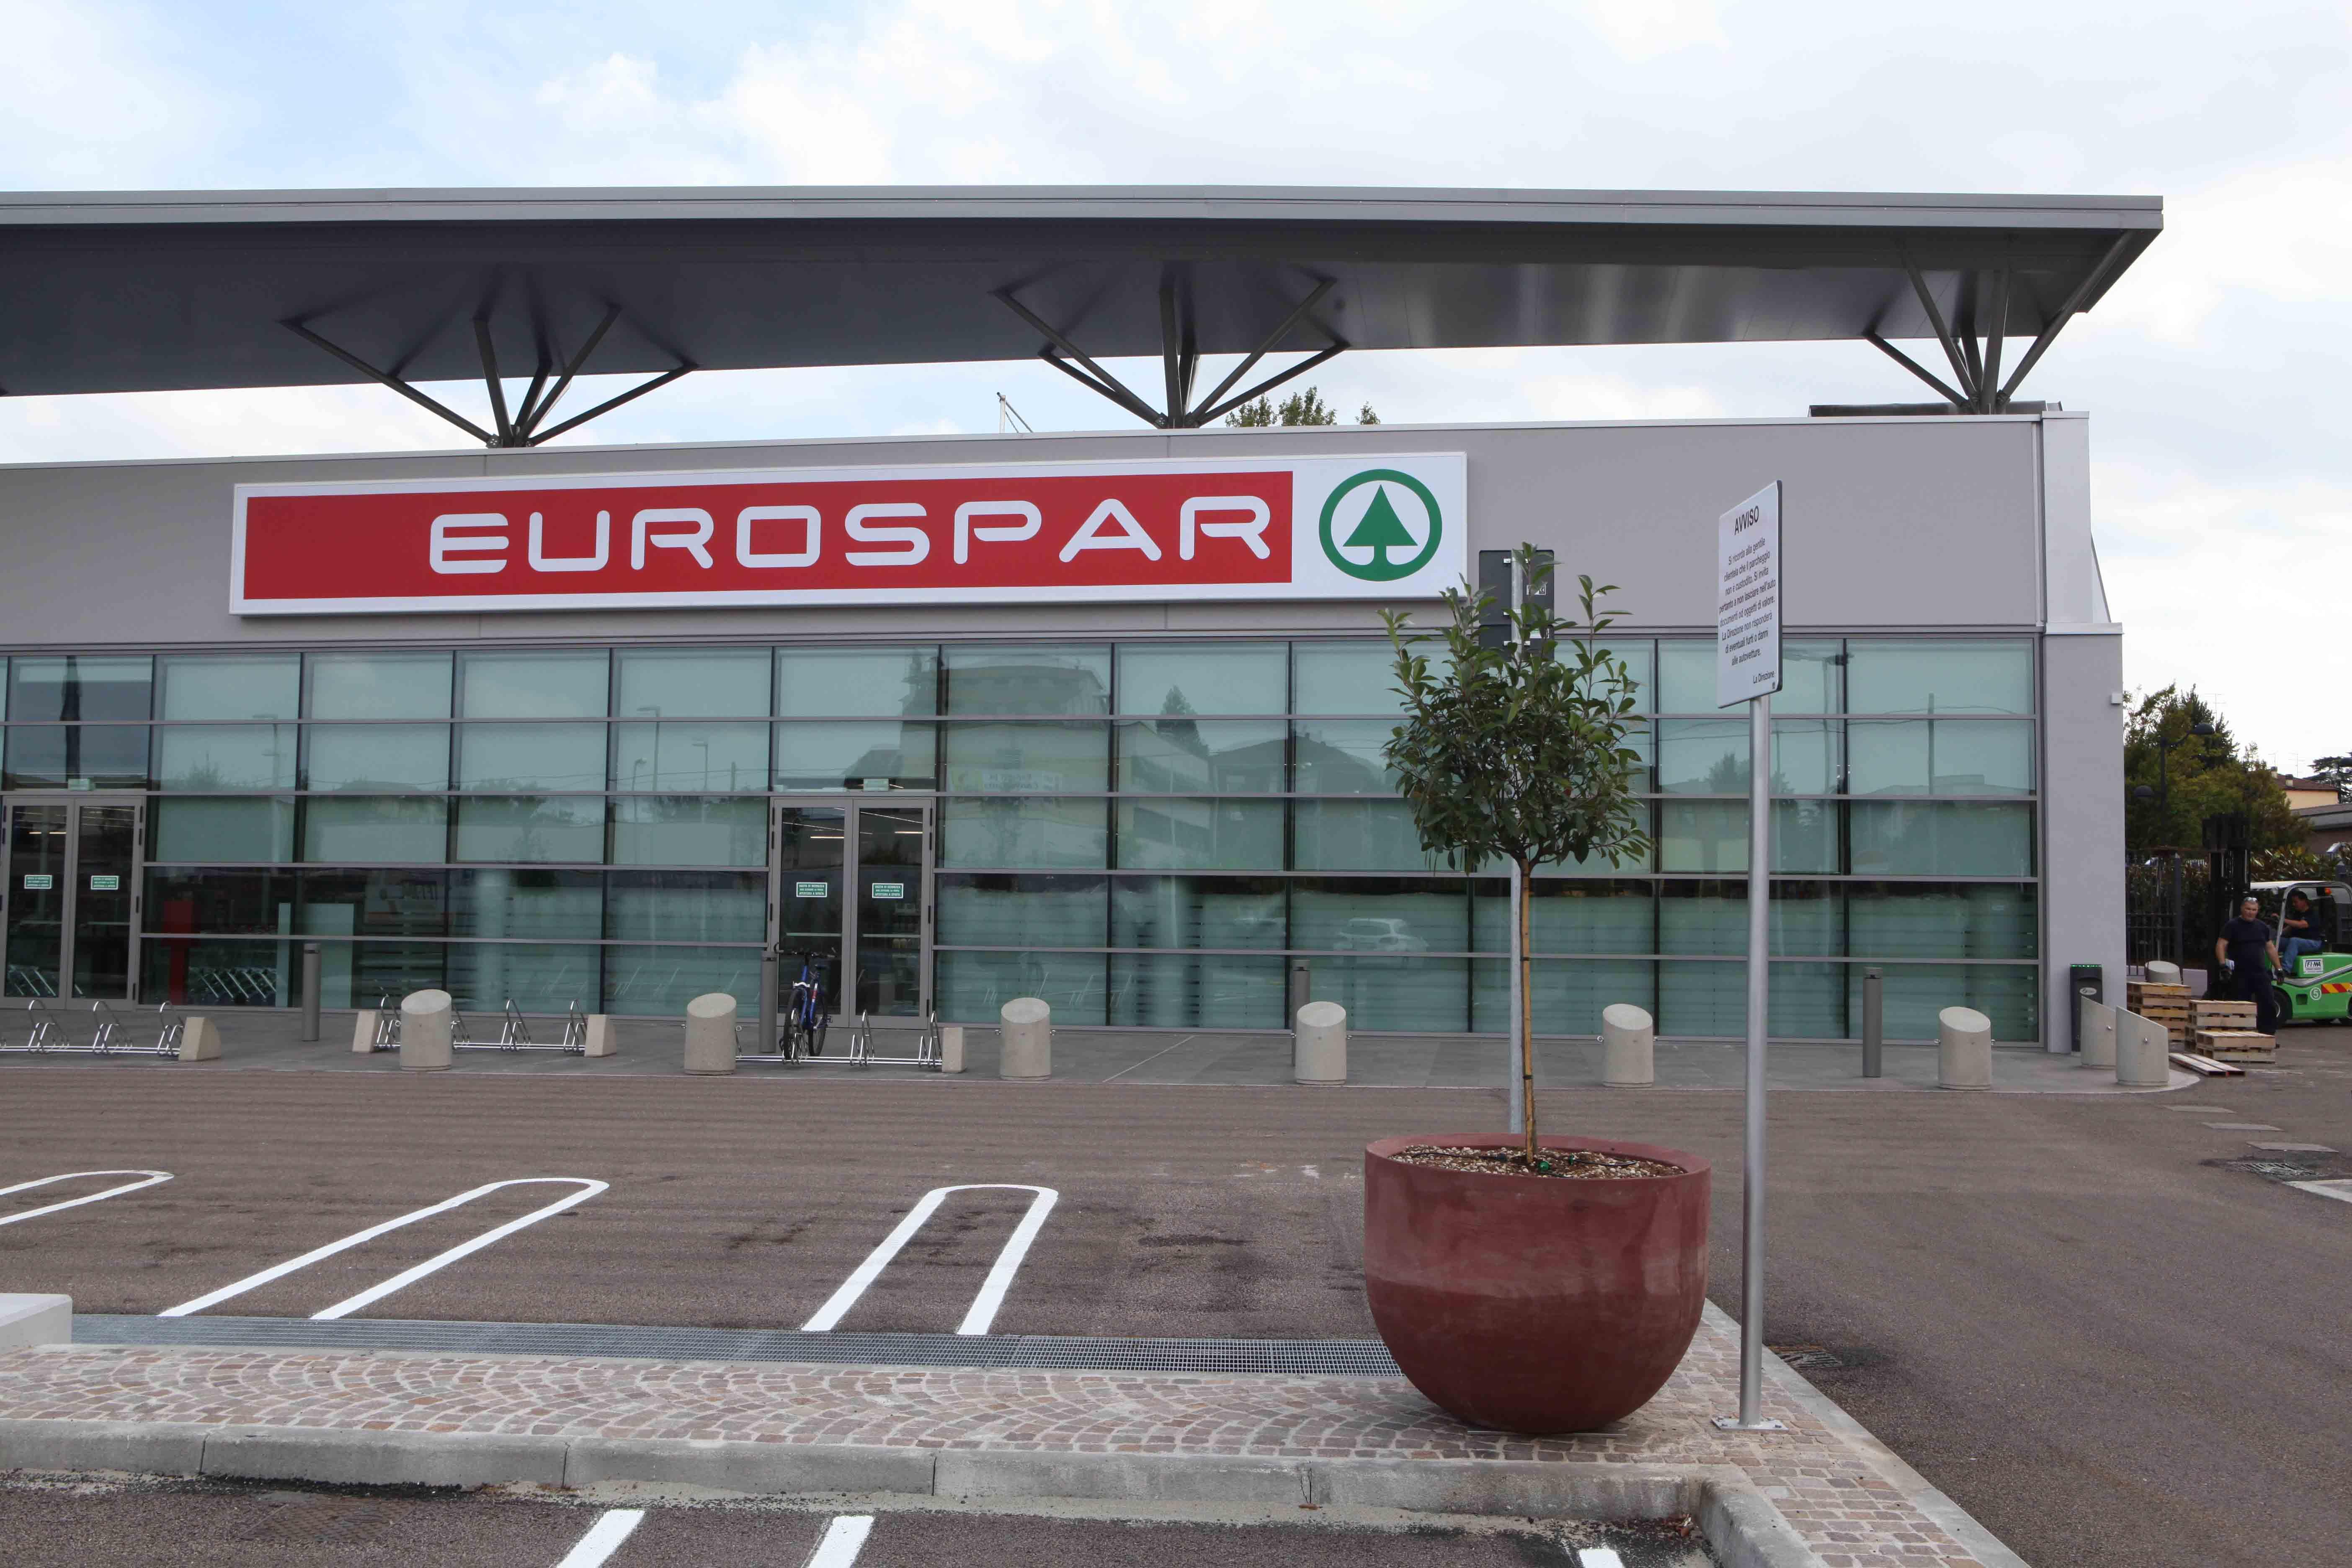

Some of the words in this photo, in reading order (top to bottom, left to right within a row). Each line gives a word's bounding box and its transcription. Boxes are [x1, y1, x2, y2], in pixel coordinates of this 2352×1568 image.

[1735, 505, 1759, 535] AVVISO
[429, 495, 1271, 574] EUROSPAR
[1749, 550, 1770, 571] parcheggio
[1754, 571, 1758, 581] Si
[1759, 566, 1769, 578] invita
[1719, 599, 1733, 615] pertanto
[1745, 588, 1759, 601] lasciare
[1759, 579, 1776, 593] nell'auto
[1720, 611, 1738, 627] documenti
[1744, 602, 1757, 617] oggetti
[1758, 601, 1761, 610] di
[1762, 596, 1775, 607] valore.
[1722, 632, 1726, 641] La
[1727, 625, 1743, 638] Direzione
[1725, 644, 1729, 653] di
[1730, 637, 1746, 652] eventuali
[1758, 628, 1768, 640] danni
[1753, 675, 1757, 683] La
[1758, 671, 1774, 682] Direzione
[2313, 989, 2318, 998] 5
